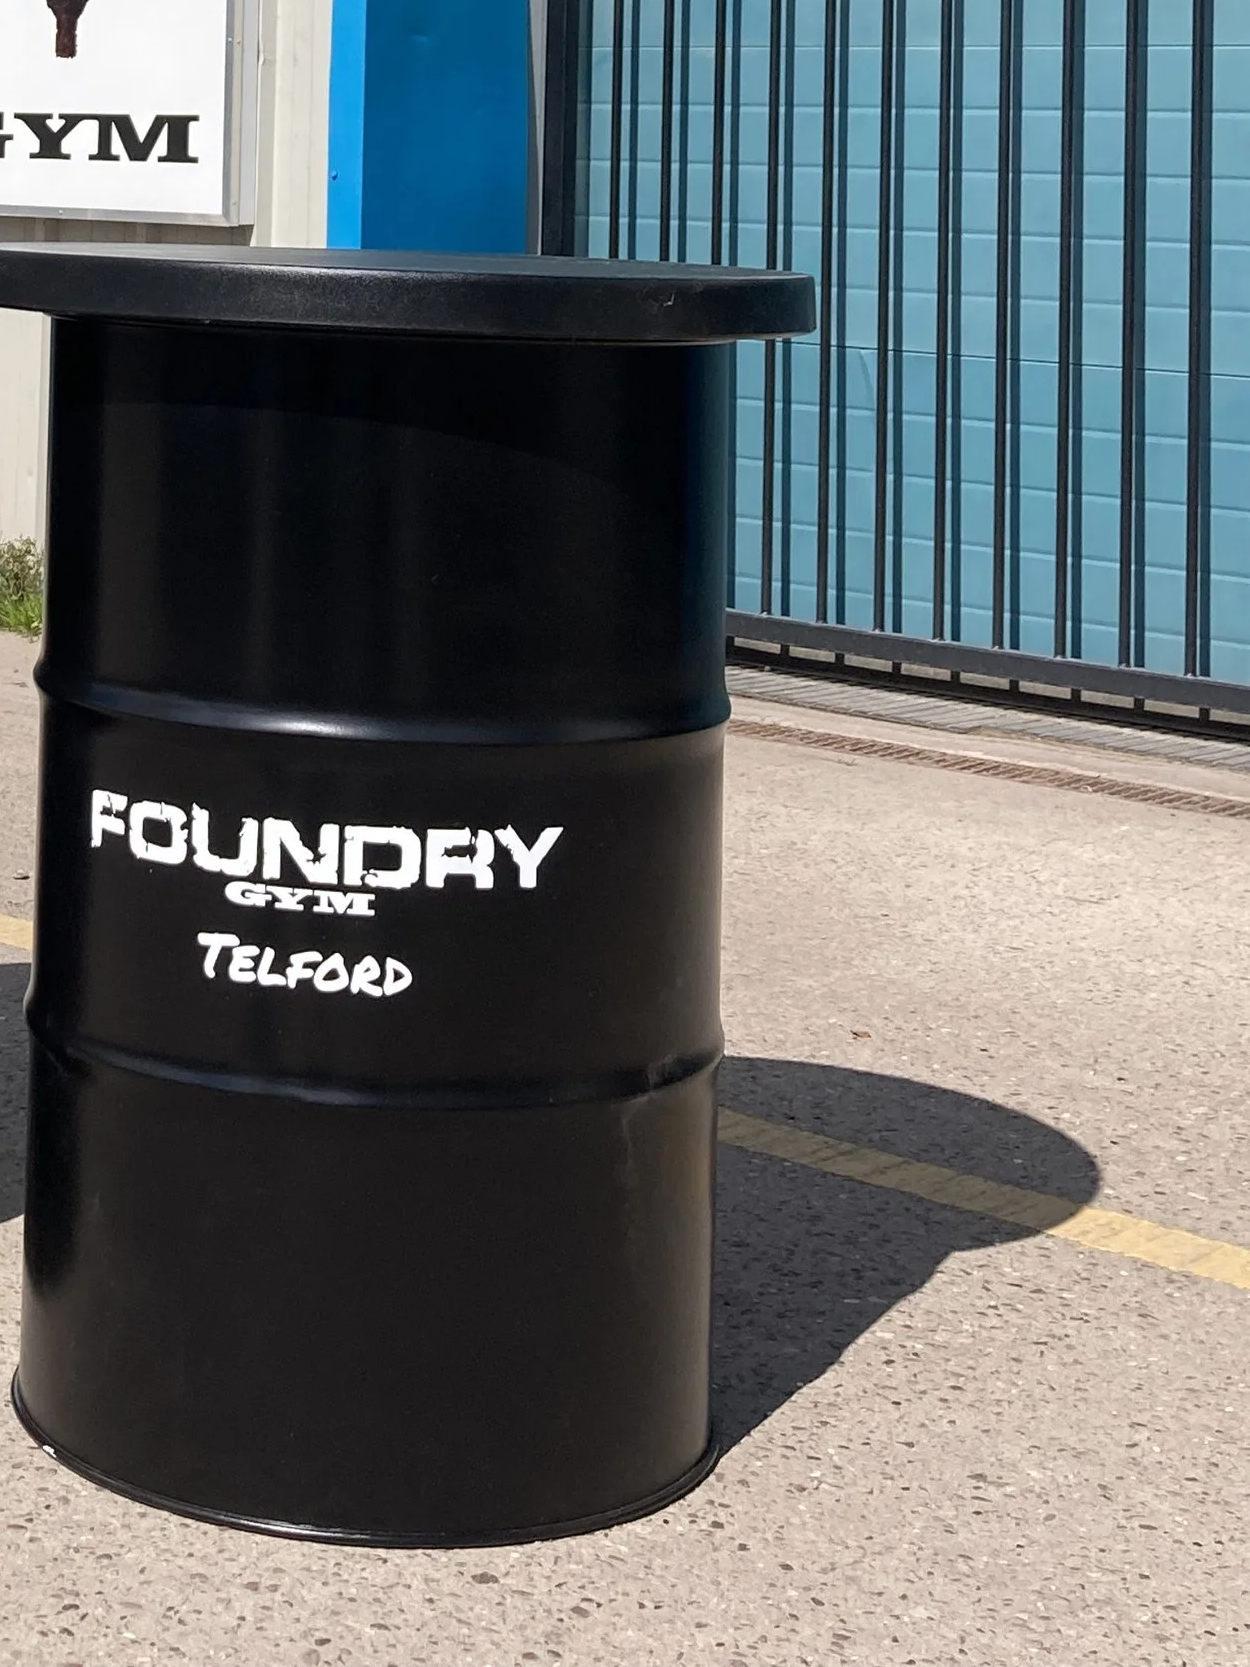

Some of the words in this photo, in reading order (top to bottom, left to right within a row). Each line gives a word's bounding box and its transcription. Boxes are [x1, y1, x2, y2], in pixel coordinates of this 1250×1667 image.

[90, 789, 565, 890] FOUNDRY
[224, 880, 377, 917] GYM
[197, 932, 414, 998] TELFORD
